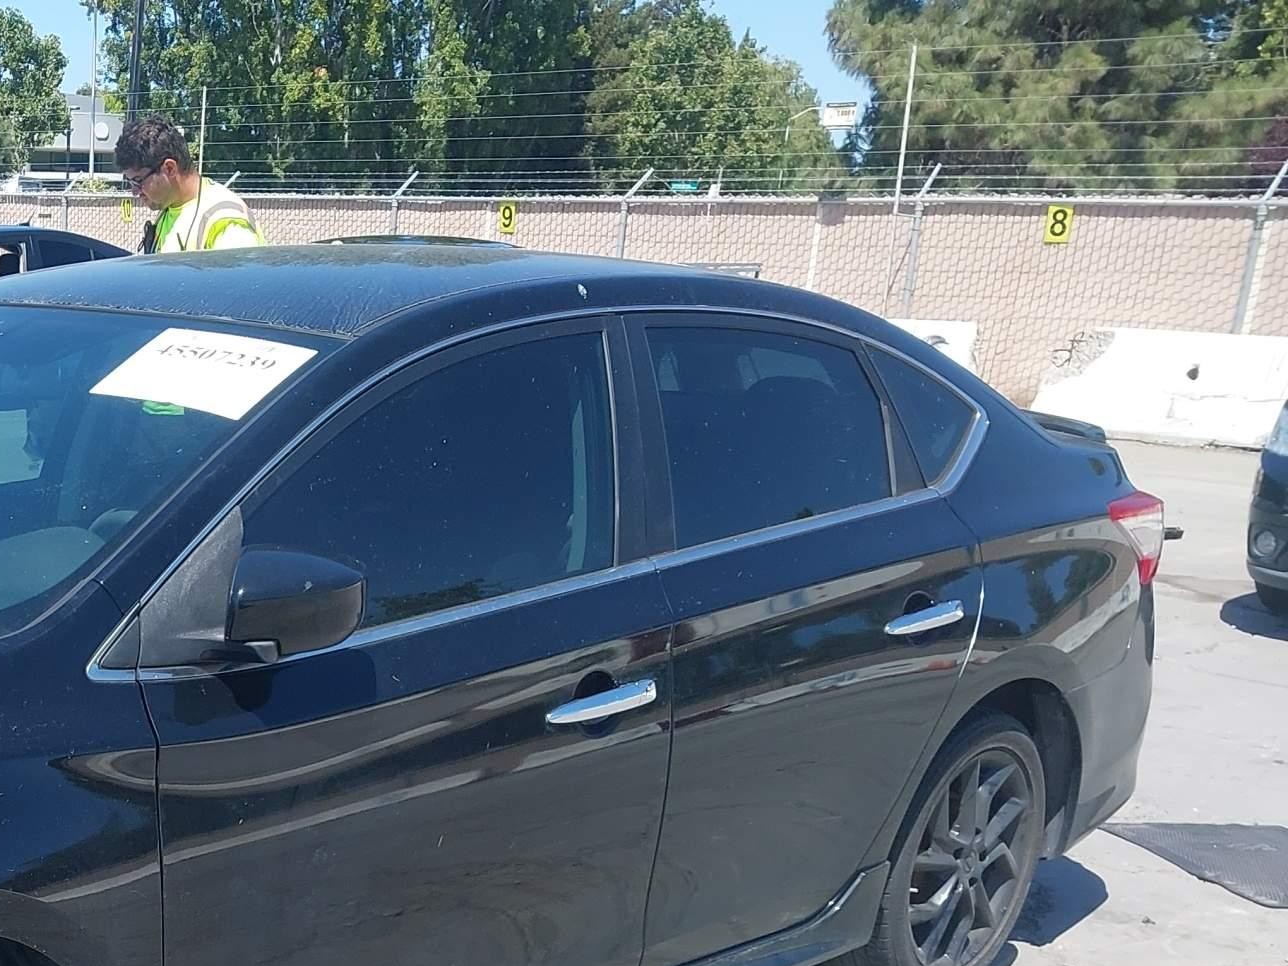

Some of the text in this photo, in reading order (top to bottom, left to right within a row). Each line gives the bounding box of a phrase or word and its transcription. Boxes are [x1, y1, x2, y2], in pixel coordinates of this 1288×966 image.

[122, 199, 131, 218] 10
[502, 205, 513, 228] 9
[1049, 208, 1068, 237] 8
[157, 344, 277, 369] 45507239
